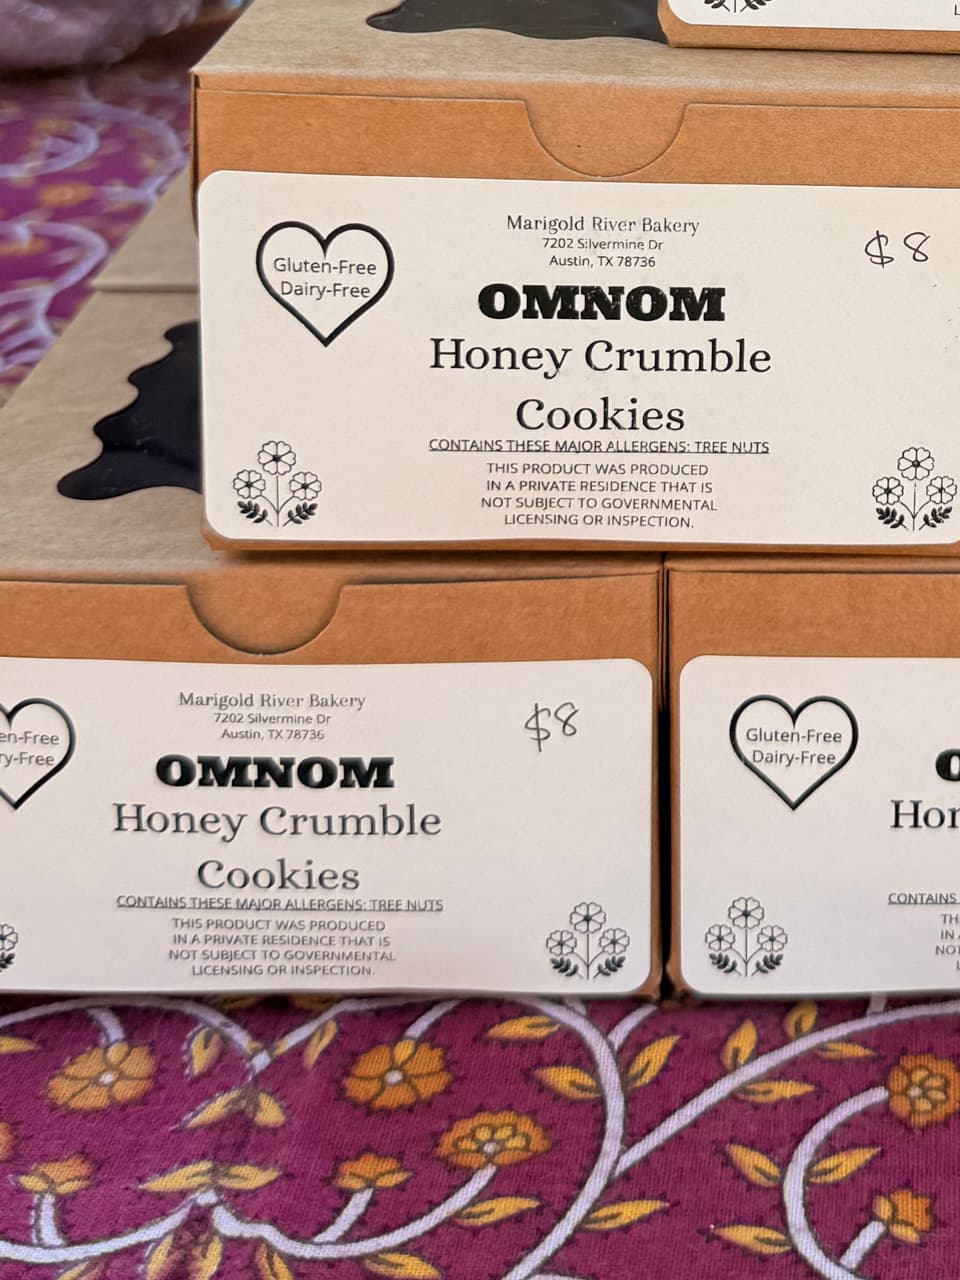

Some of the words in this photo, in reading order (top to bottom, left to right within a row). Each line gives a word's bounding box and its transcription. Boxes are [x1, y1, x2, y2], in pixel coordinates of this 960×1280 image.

[506, 214, 584, 236] Marigold
[591, 216, 636, 232] River
[642, 216, 700, 237] Bakery
[542, 237, 573, 249] 7202
[577, 237, 644, 250] Silvermine
[648, 239, 664, 250] Dr
[864, 229, 931, 269] $8
[272, 257, 377, 275] Gluten-Free
[548, 254, 593, 268] Austin,
[596, 255, 613, 267] TX
[616, 255, 656, 268] 78736
[279, 281, 372, 301] Dairy-Free
[477, 282, 726, 323] OMNOM
[429, 337, 571, 380] Honey
[584, 336, 771, 374] Crumble
[516, 394, 685, 432] Cookies
[429, 438, 503, 450] CONTAINS
[506, 439, 550, 451] THESE
[555, 439, 602, 453] MAJOR
[605, 439, 690, 452] ALLERGENS:
[693, 441, 727, 453] TREE
[731, 440, 769, 453] NUTS
[179, 691, 255, 711] Marigold
[260, 693, 305, 707] River
[309, 693, 366, 711] Bakery
[213, 712, 244, 723] 7202
[247, 713, 313, 724] Silvermine
[316, 714, 332, 724] Dr
[524, 701, 580, 753] $8
[220, 728, 264, 740] Austin,
[266, 728, 283, 739] TX
[286, 729, 325, 740] 78736
[745, 727, 842, 743] Gluten-Free
[752, 749, 837, 767] Dairy-Free
[153, 755, 395, 789] OMNOM
[110, 804, 249, 842] Honey
[258, 803, 441, 836] Crumble
[195, 856, 360, 890] Cookies
[888, 892, 957, 903] CONTAINS
